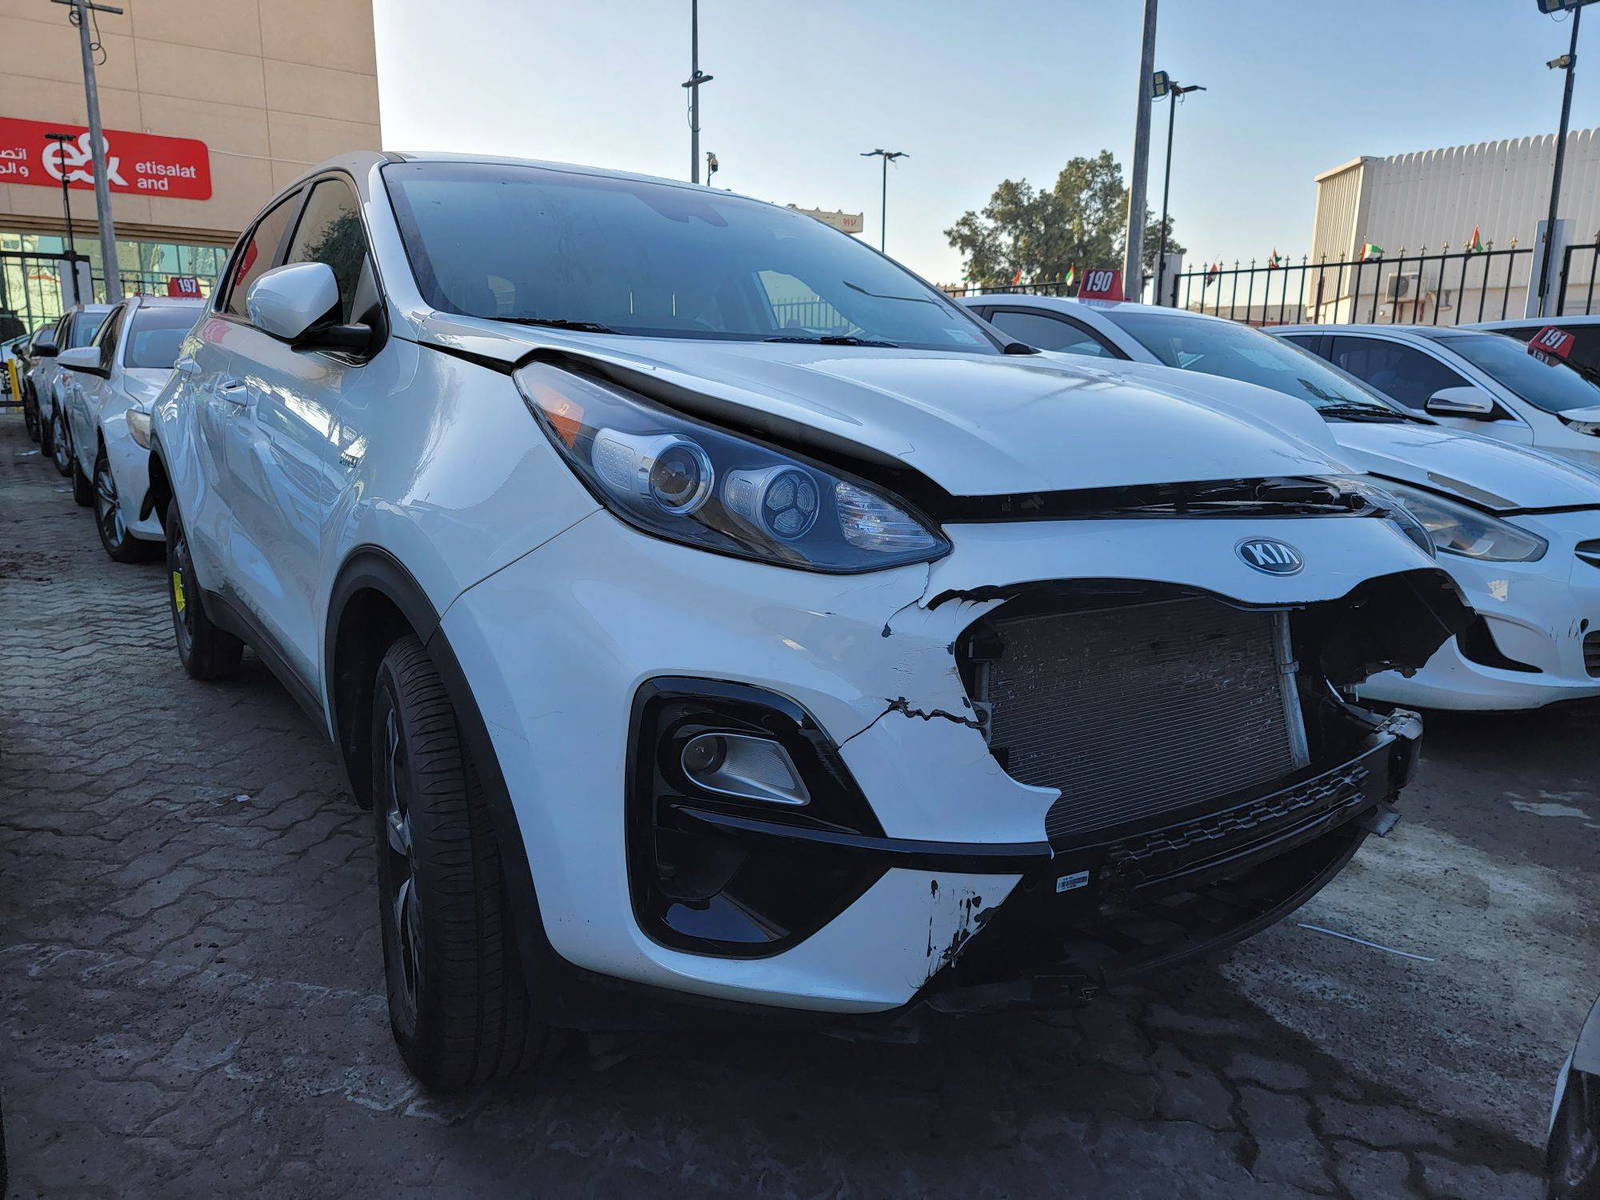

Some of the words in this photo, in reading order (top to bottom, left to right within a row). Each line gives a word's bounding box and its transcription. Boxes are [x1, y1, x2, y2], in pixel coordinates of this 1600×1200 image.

[135, 160, 197, 179] etisalat
[136, 177, 169, 191] and
[178, 279, 197, 293] 197
[1086, 270, 1114, 292] 190
[1540, 328, 1568, 349] 191
[1245, 543, 1300, 566] KIA
